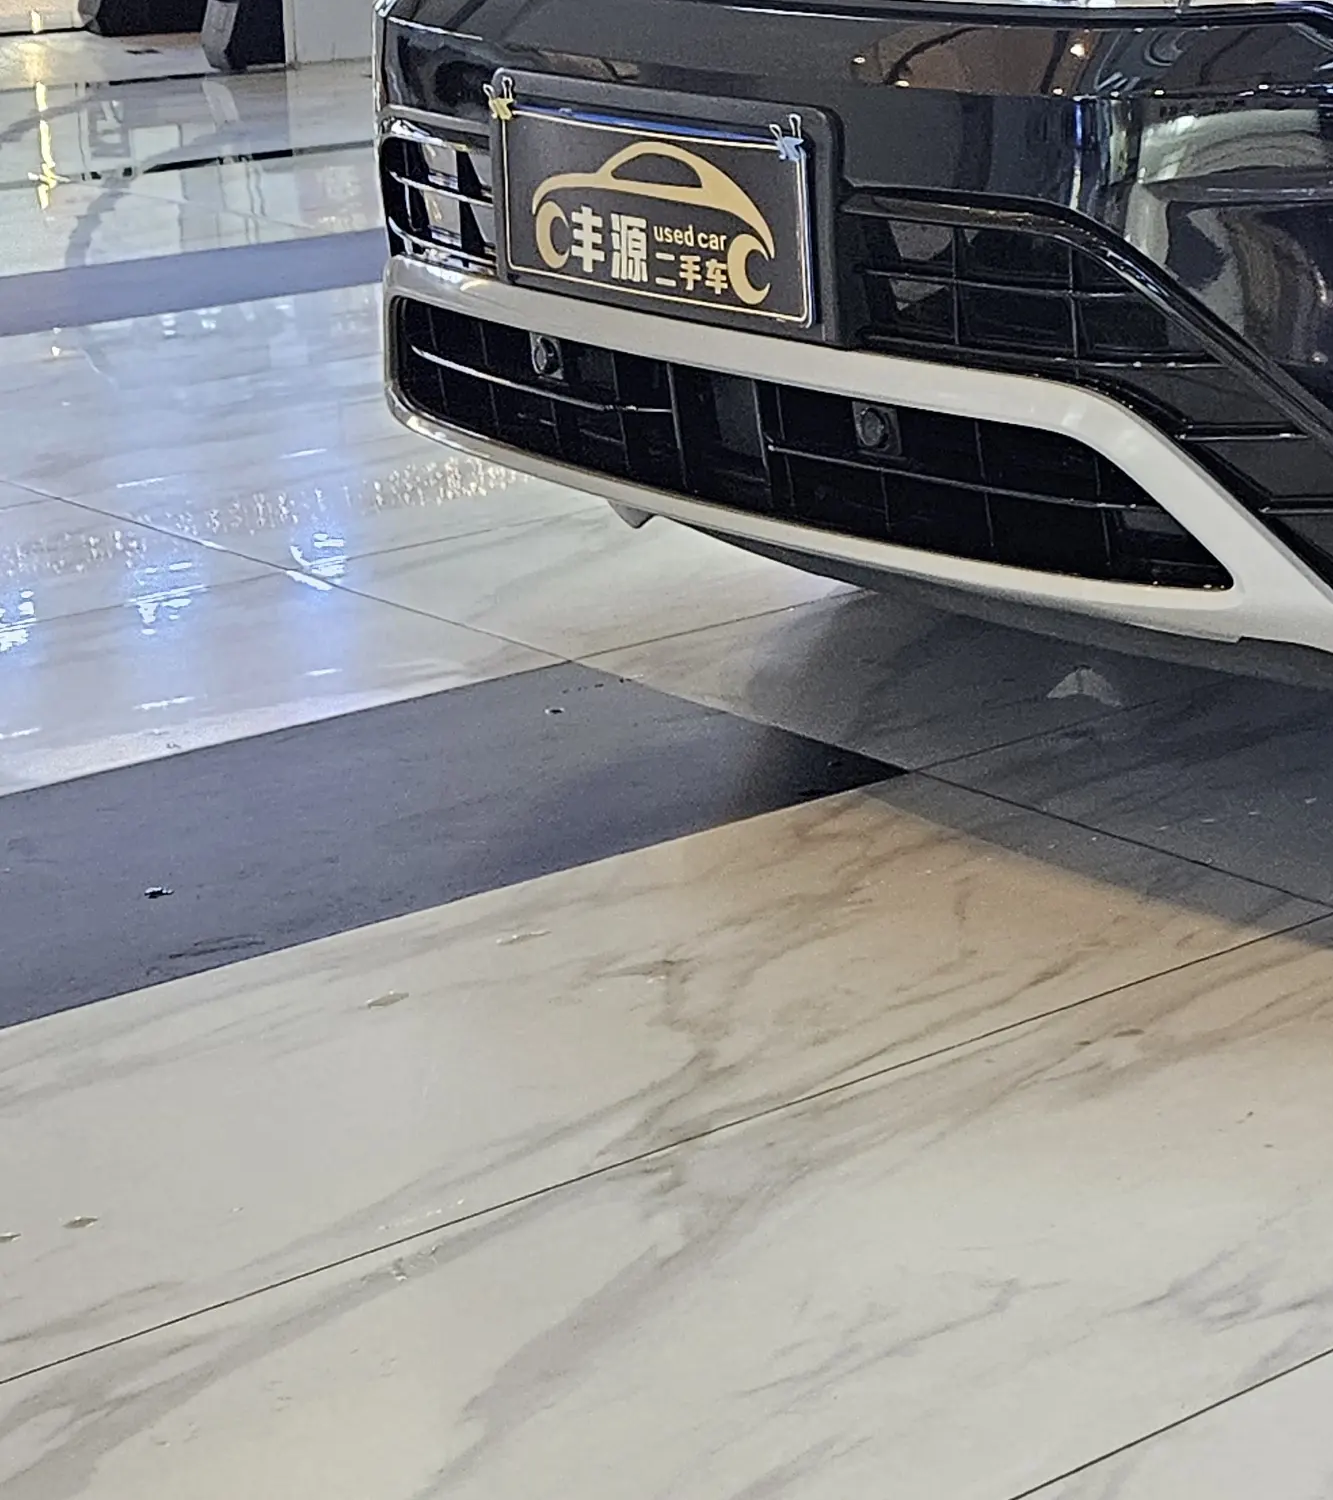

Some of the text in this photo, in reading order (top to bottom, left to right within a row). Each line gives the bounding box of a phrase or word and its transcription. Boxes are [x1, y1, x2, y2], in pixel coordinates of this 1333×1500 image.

[571, 204, 649, 284] 丰源
[653, 224, 727, 252] used car
[655, 252, 729, 296] 二手车
